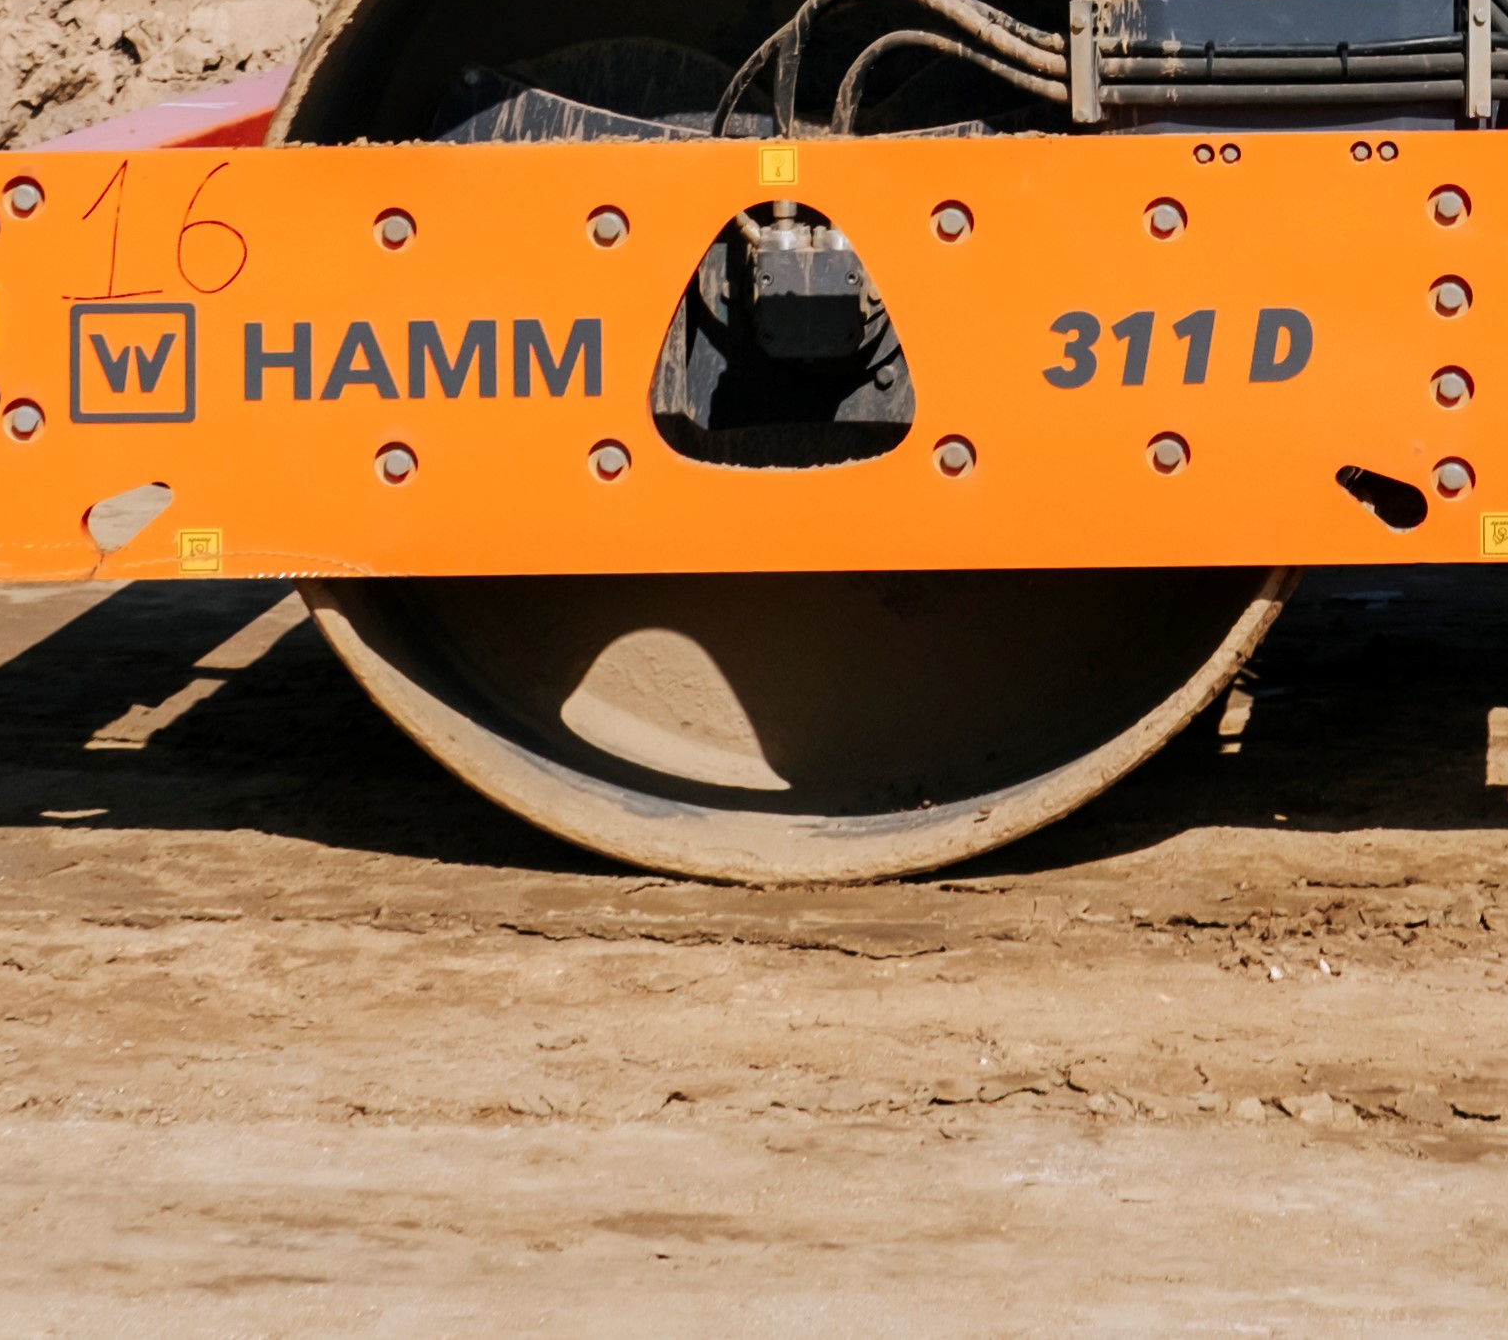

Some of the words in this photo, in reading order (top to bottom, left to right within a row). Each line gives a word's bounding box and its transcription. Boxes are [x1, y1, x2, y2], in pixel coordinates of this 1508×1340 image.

[61, 159, 248, 301] 16
[243, 319, 602, 401] HAMM
[1042, 309, 1216, 390] 311
[1248, 307, 1314, 383] D
